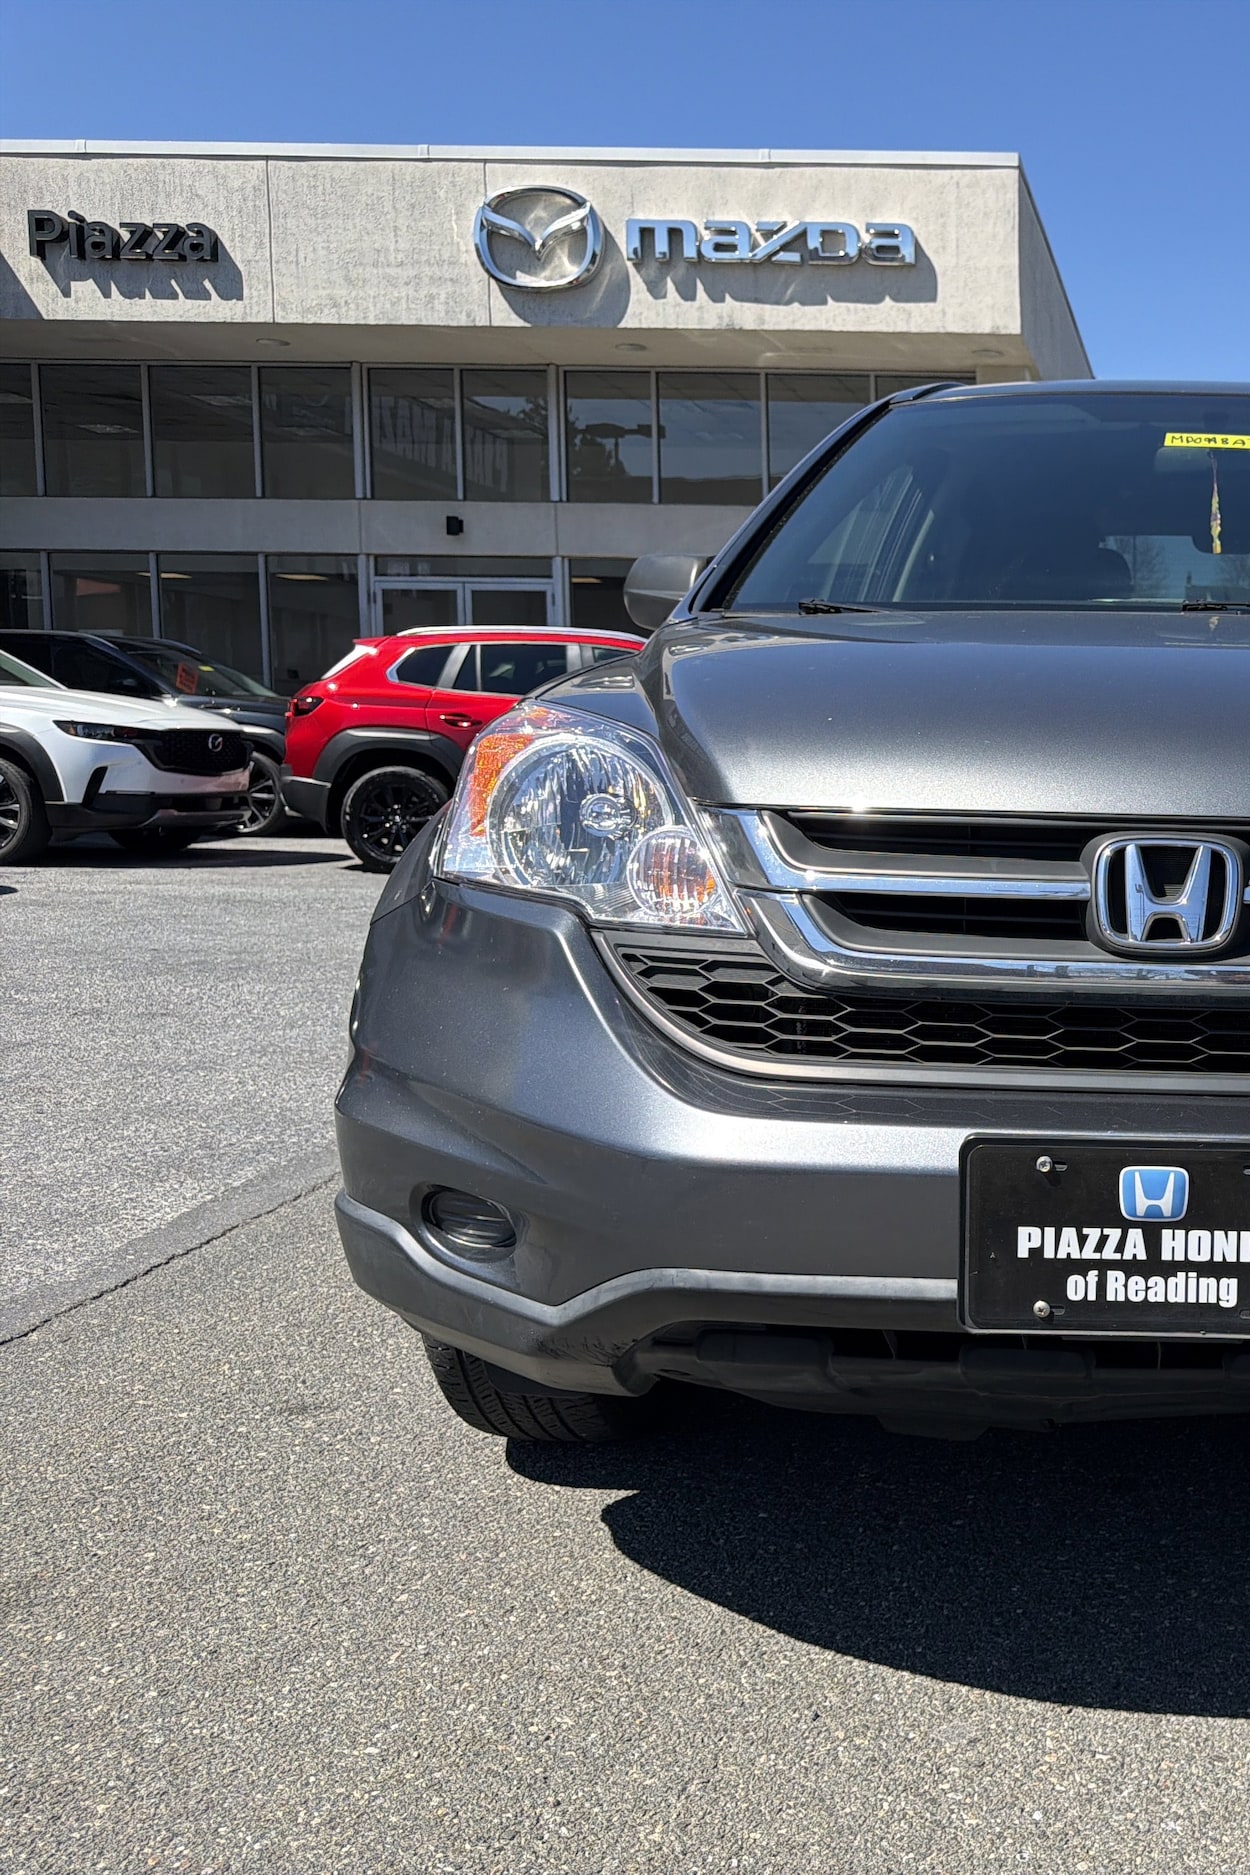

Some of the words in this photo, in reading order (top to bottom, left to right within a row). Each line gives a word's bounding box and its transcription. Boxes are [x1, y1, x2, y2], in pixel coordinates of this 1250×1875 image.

[27, 209, 218, 262] Piazza
[1017, 1226, 1147, 1261] PIAZZA
[1066, 1270, 1099, 1301] of
[1106, 1270, 1238, 1308] Reading
